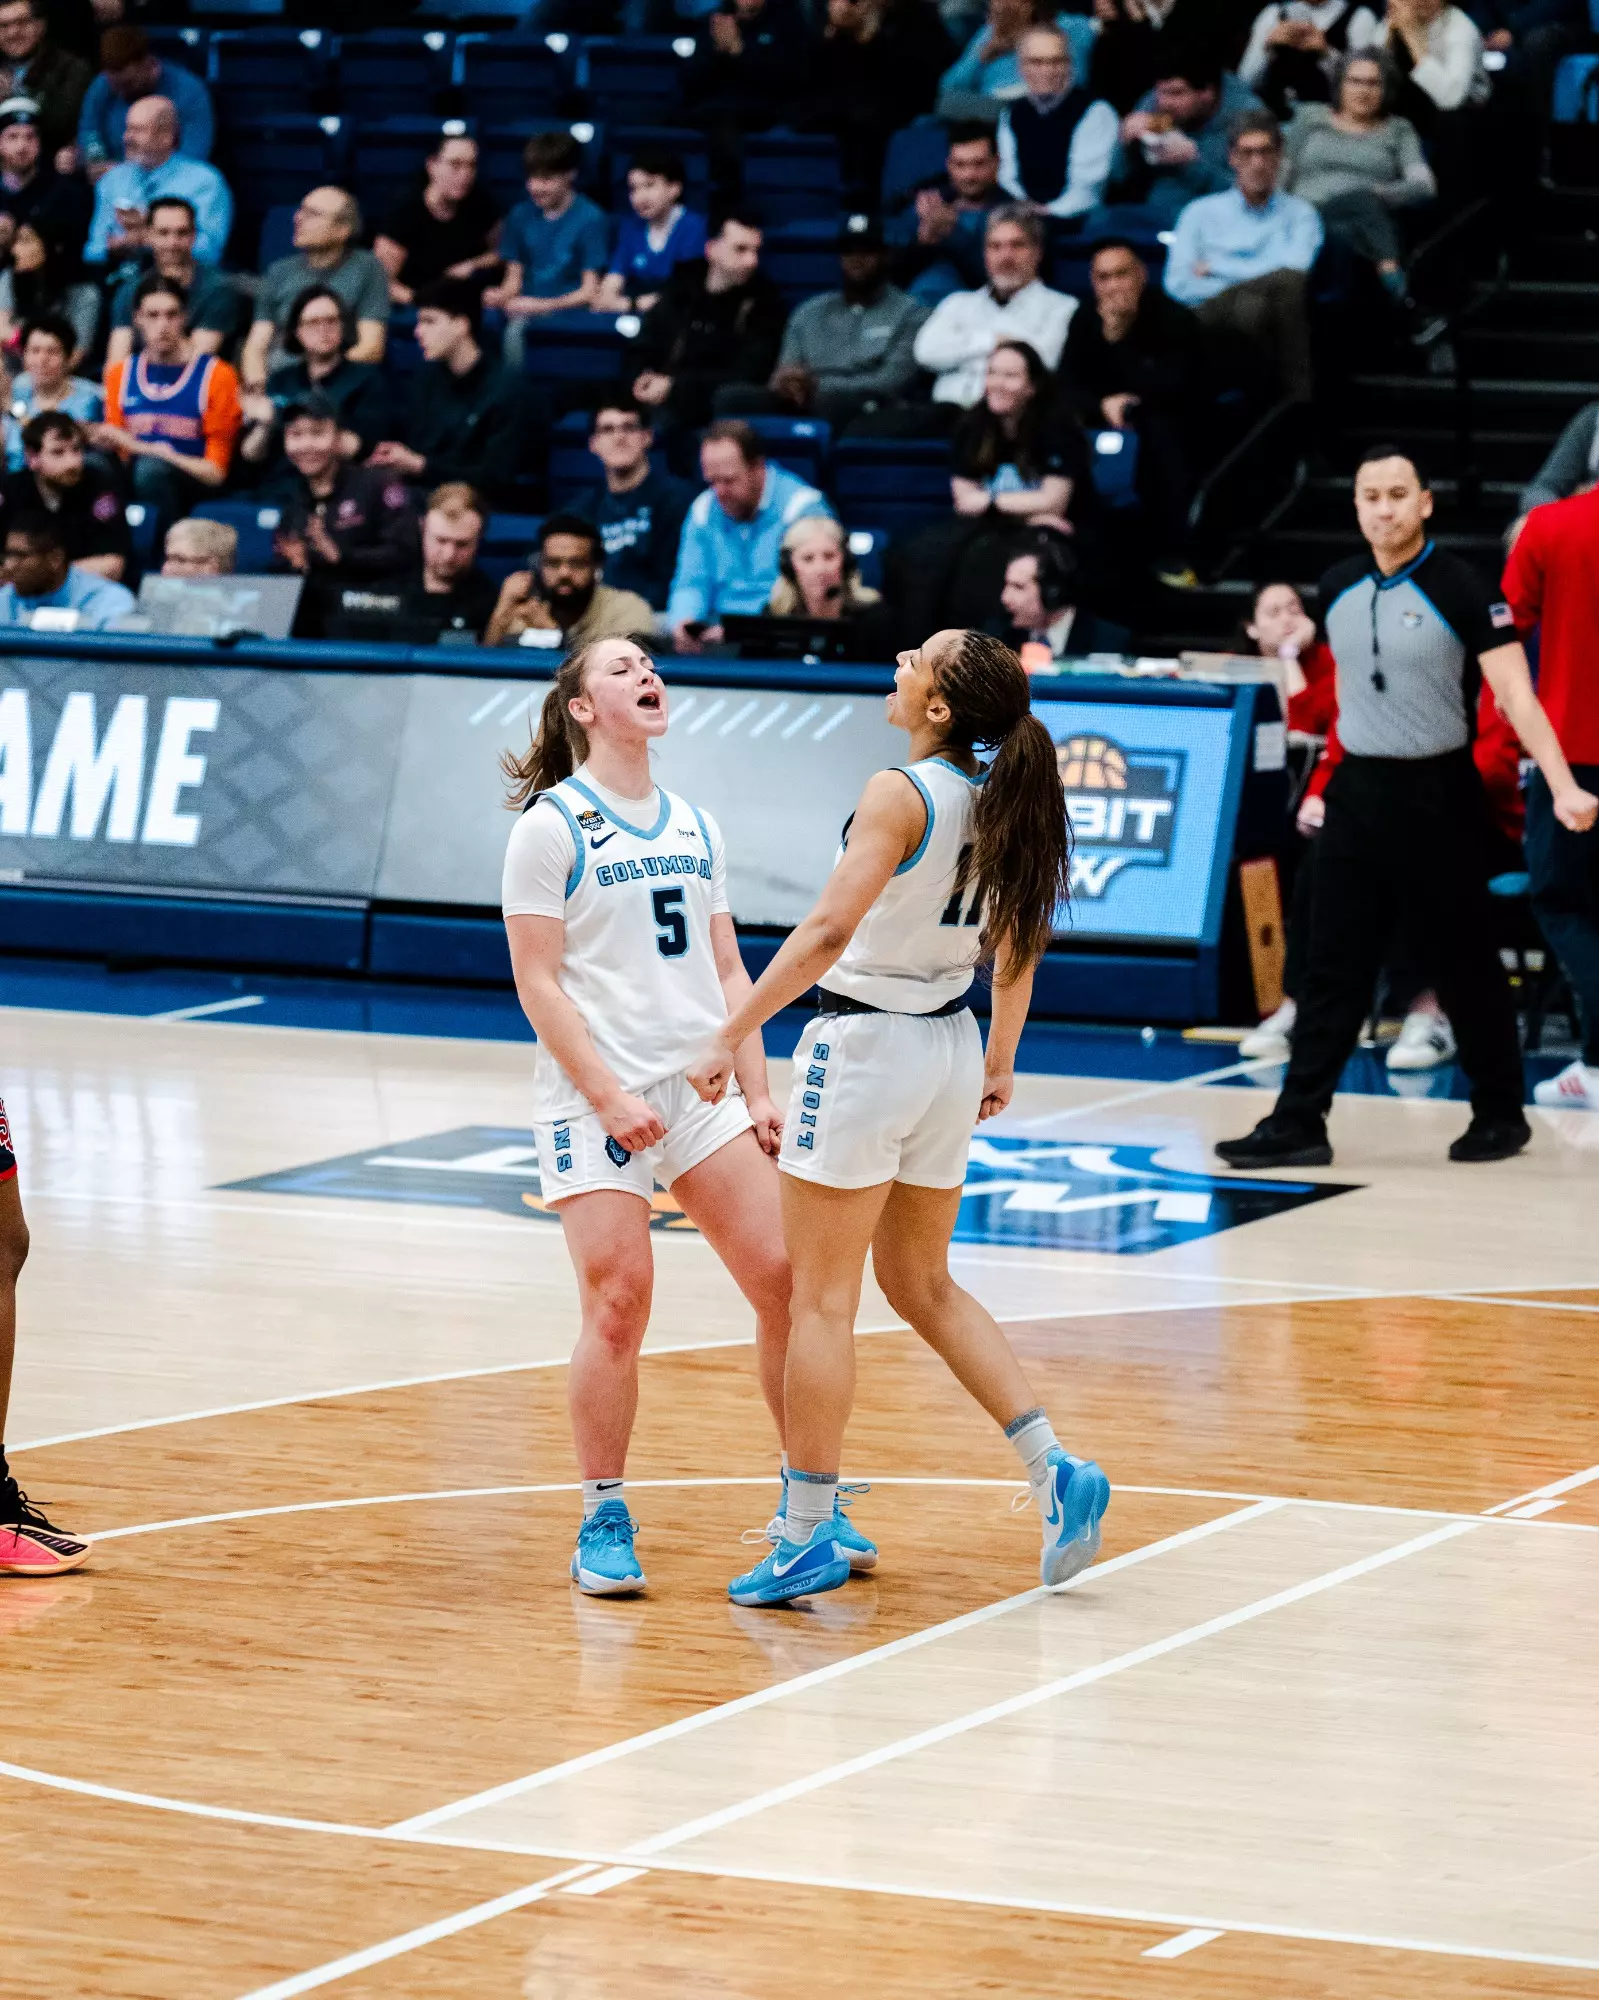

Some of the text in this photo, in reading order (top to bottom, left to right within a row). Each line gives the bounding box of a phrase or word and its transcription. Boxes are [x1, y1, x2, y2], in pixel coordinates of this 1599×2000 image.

[1065, 795, 1174, 843] BIT
[596, 855, 711, 886] COLUMBA
[651, 885, 691, 960] 5
[797, 1042, 830, 1151] LIONS
